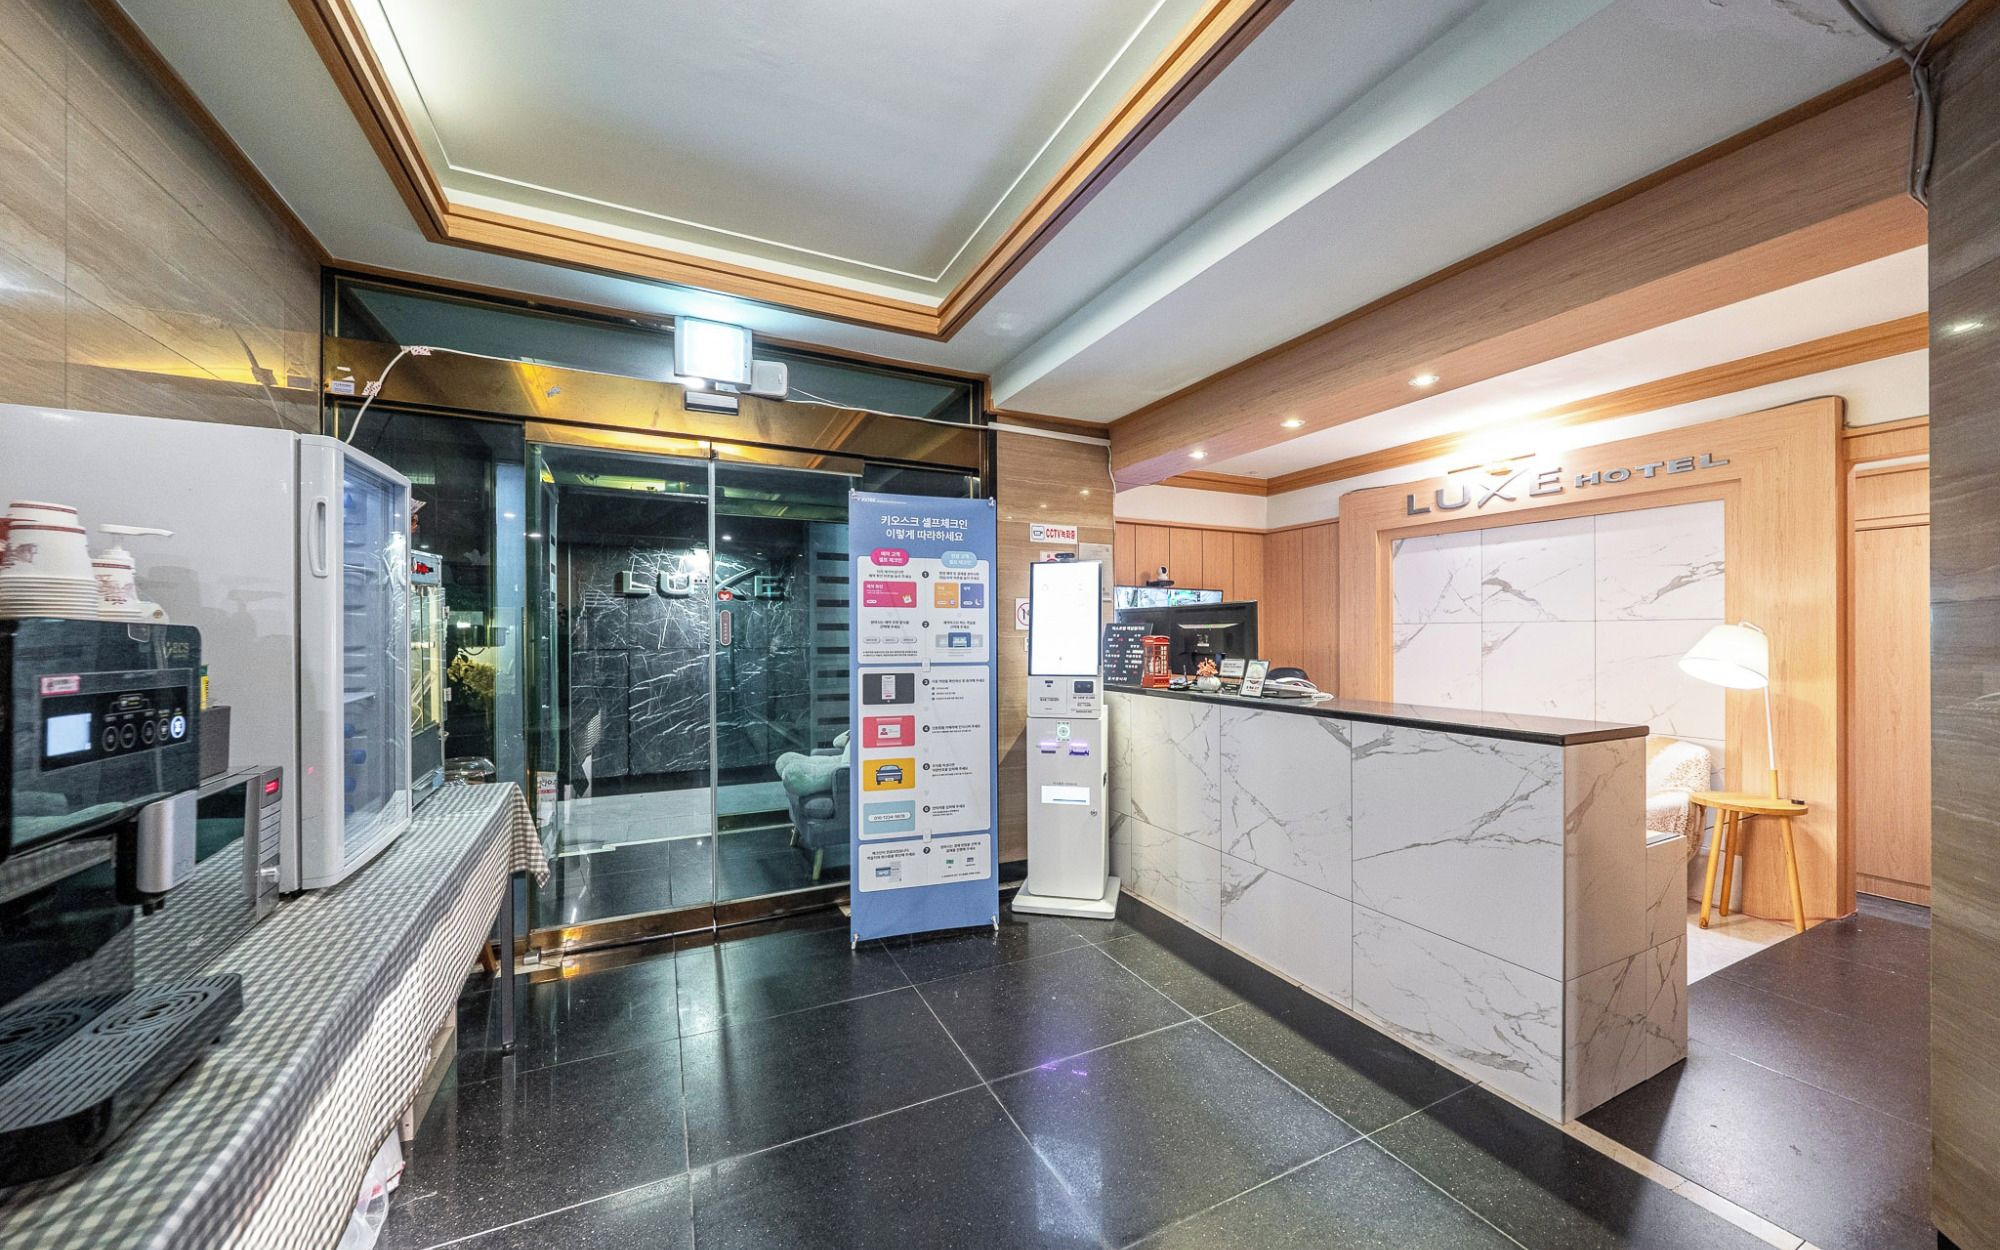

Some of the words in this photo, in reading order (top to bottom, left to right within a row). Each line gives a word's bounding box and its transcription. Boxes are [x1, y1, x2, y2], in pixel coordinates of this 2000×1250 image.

[1407, 467, 1563, 517] LUXE
[1575, 453, 1731, 488] HOTEL
[880, 515, 919, 527] 키오스크
[922, 516, 968, 530] 셀프체크인
[886, 529, 915, 541] 이렇게
[917, 530, 964, 542] 따라하세요
[614, 567, 785, 600] LUXE
